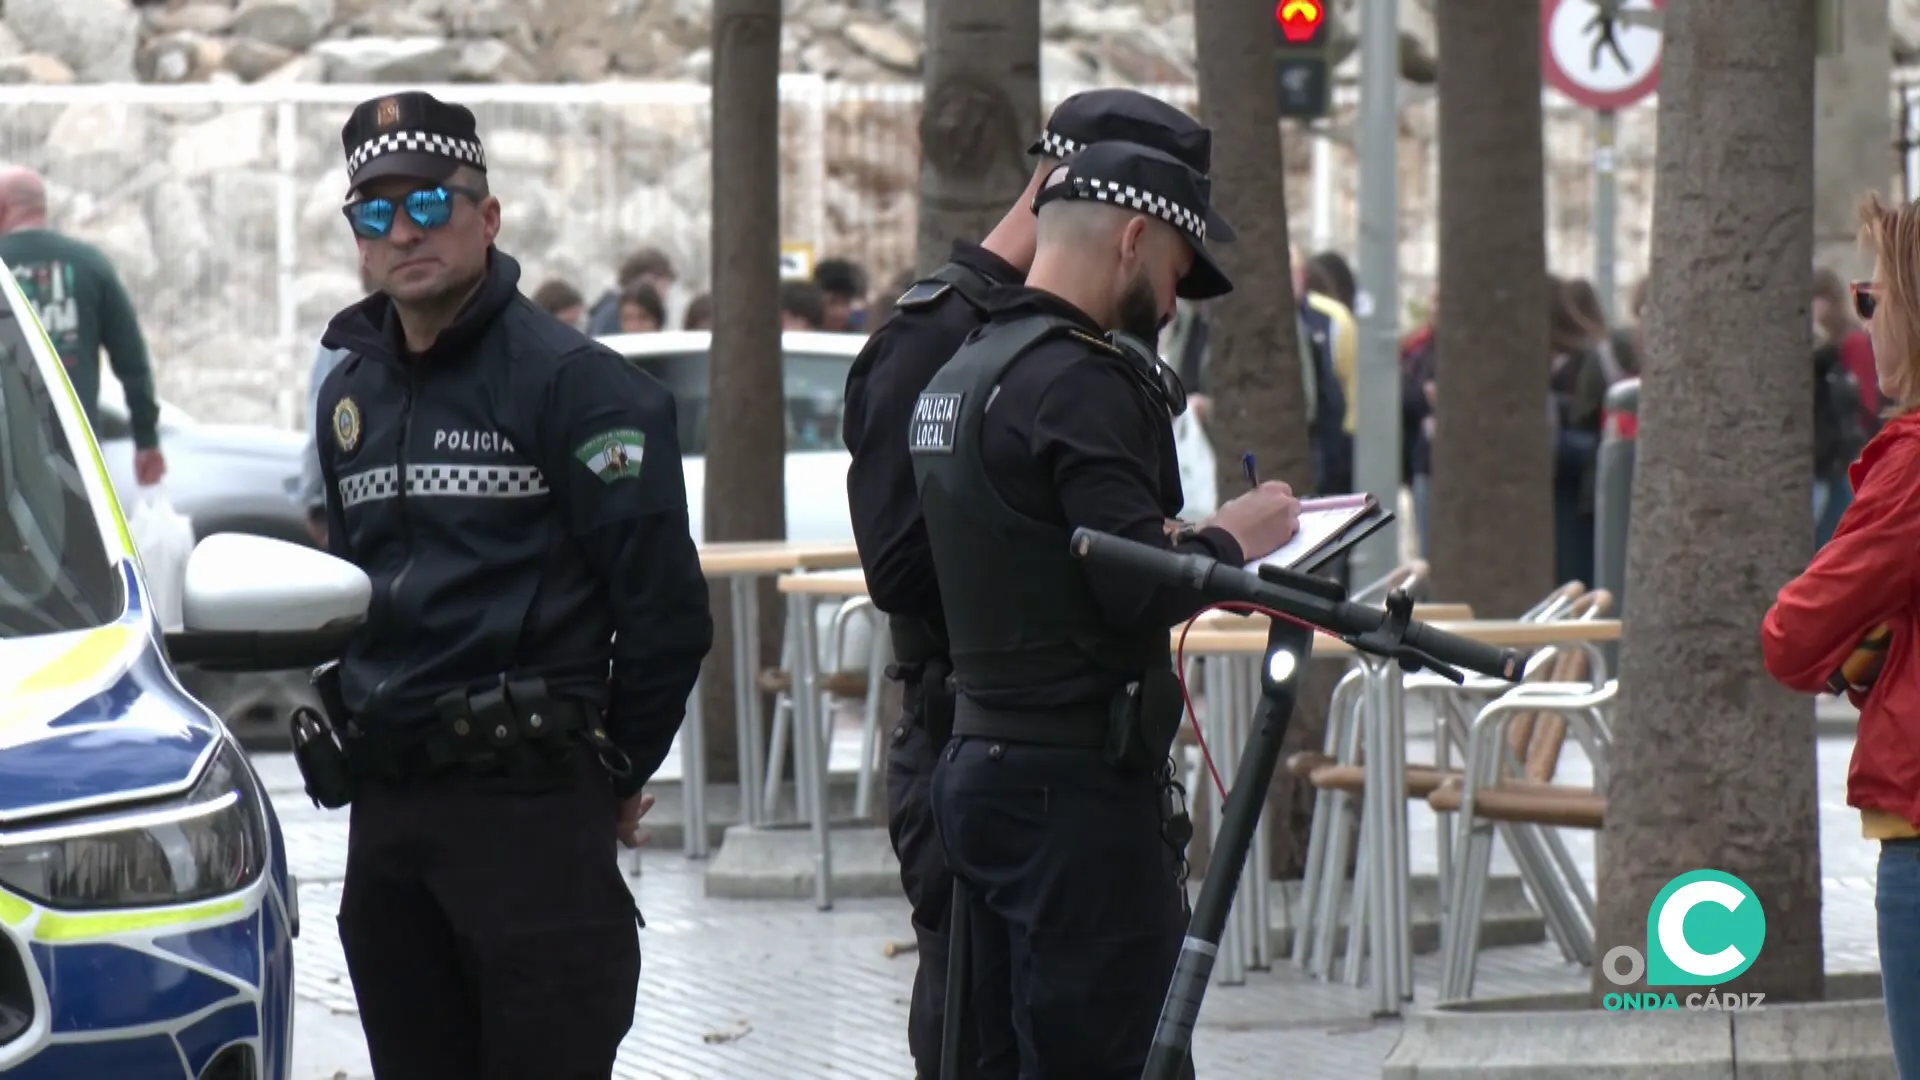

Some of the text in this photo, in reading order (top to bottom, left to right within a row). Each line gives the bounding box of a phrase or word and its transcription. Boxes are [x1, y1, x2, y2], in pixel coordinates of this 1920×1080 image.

[916, 398, 954, 421] POLICIA
[433, 429, 515, 453] POLICIA
[916, 423, 944, 446] LOCAL
